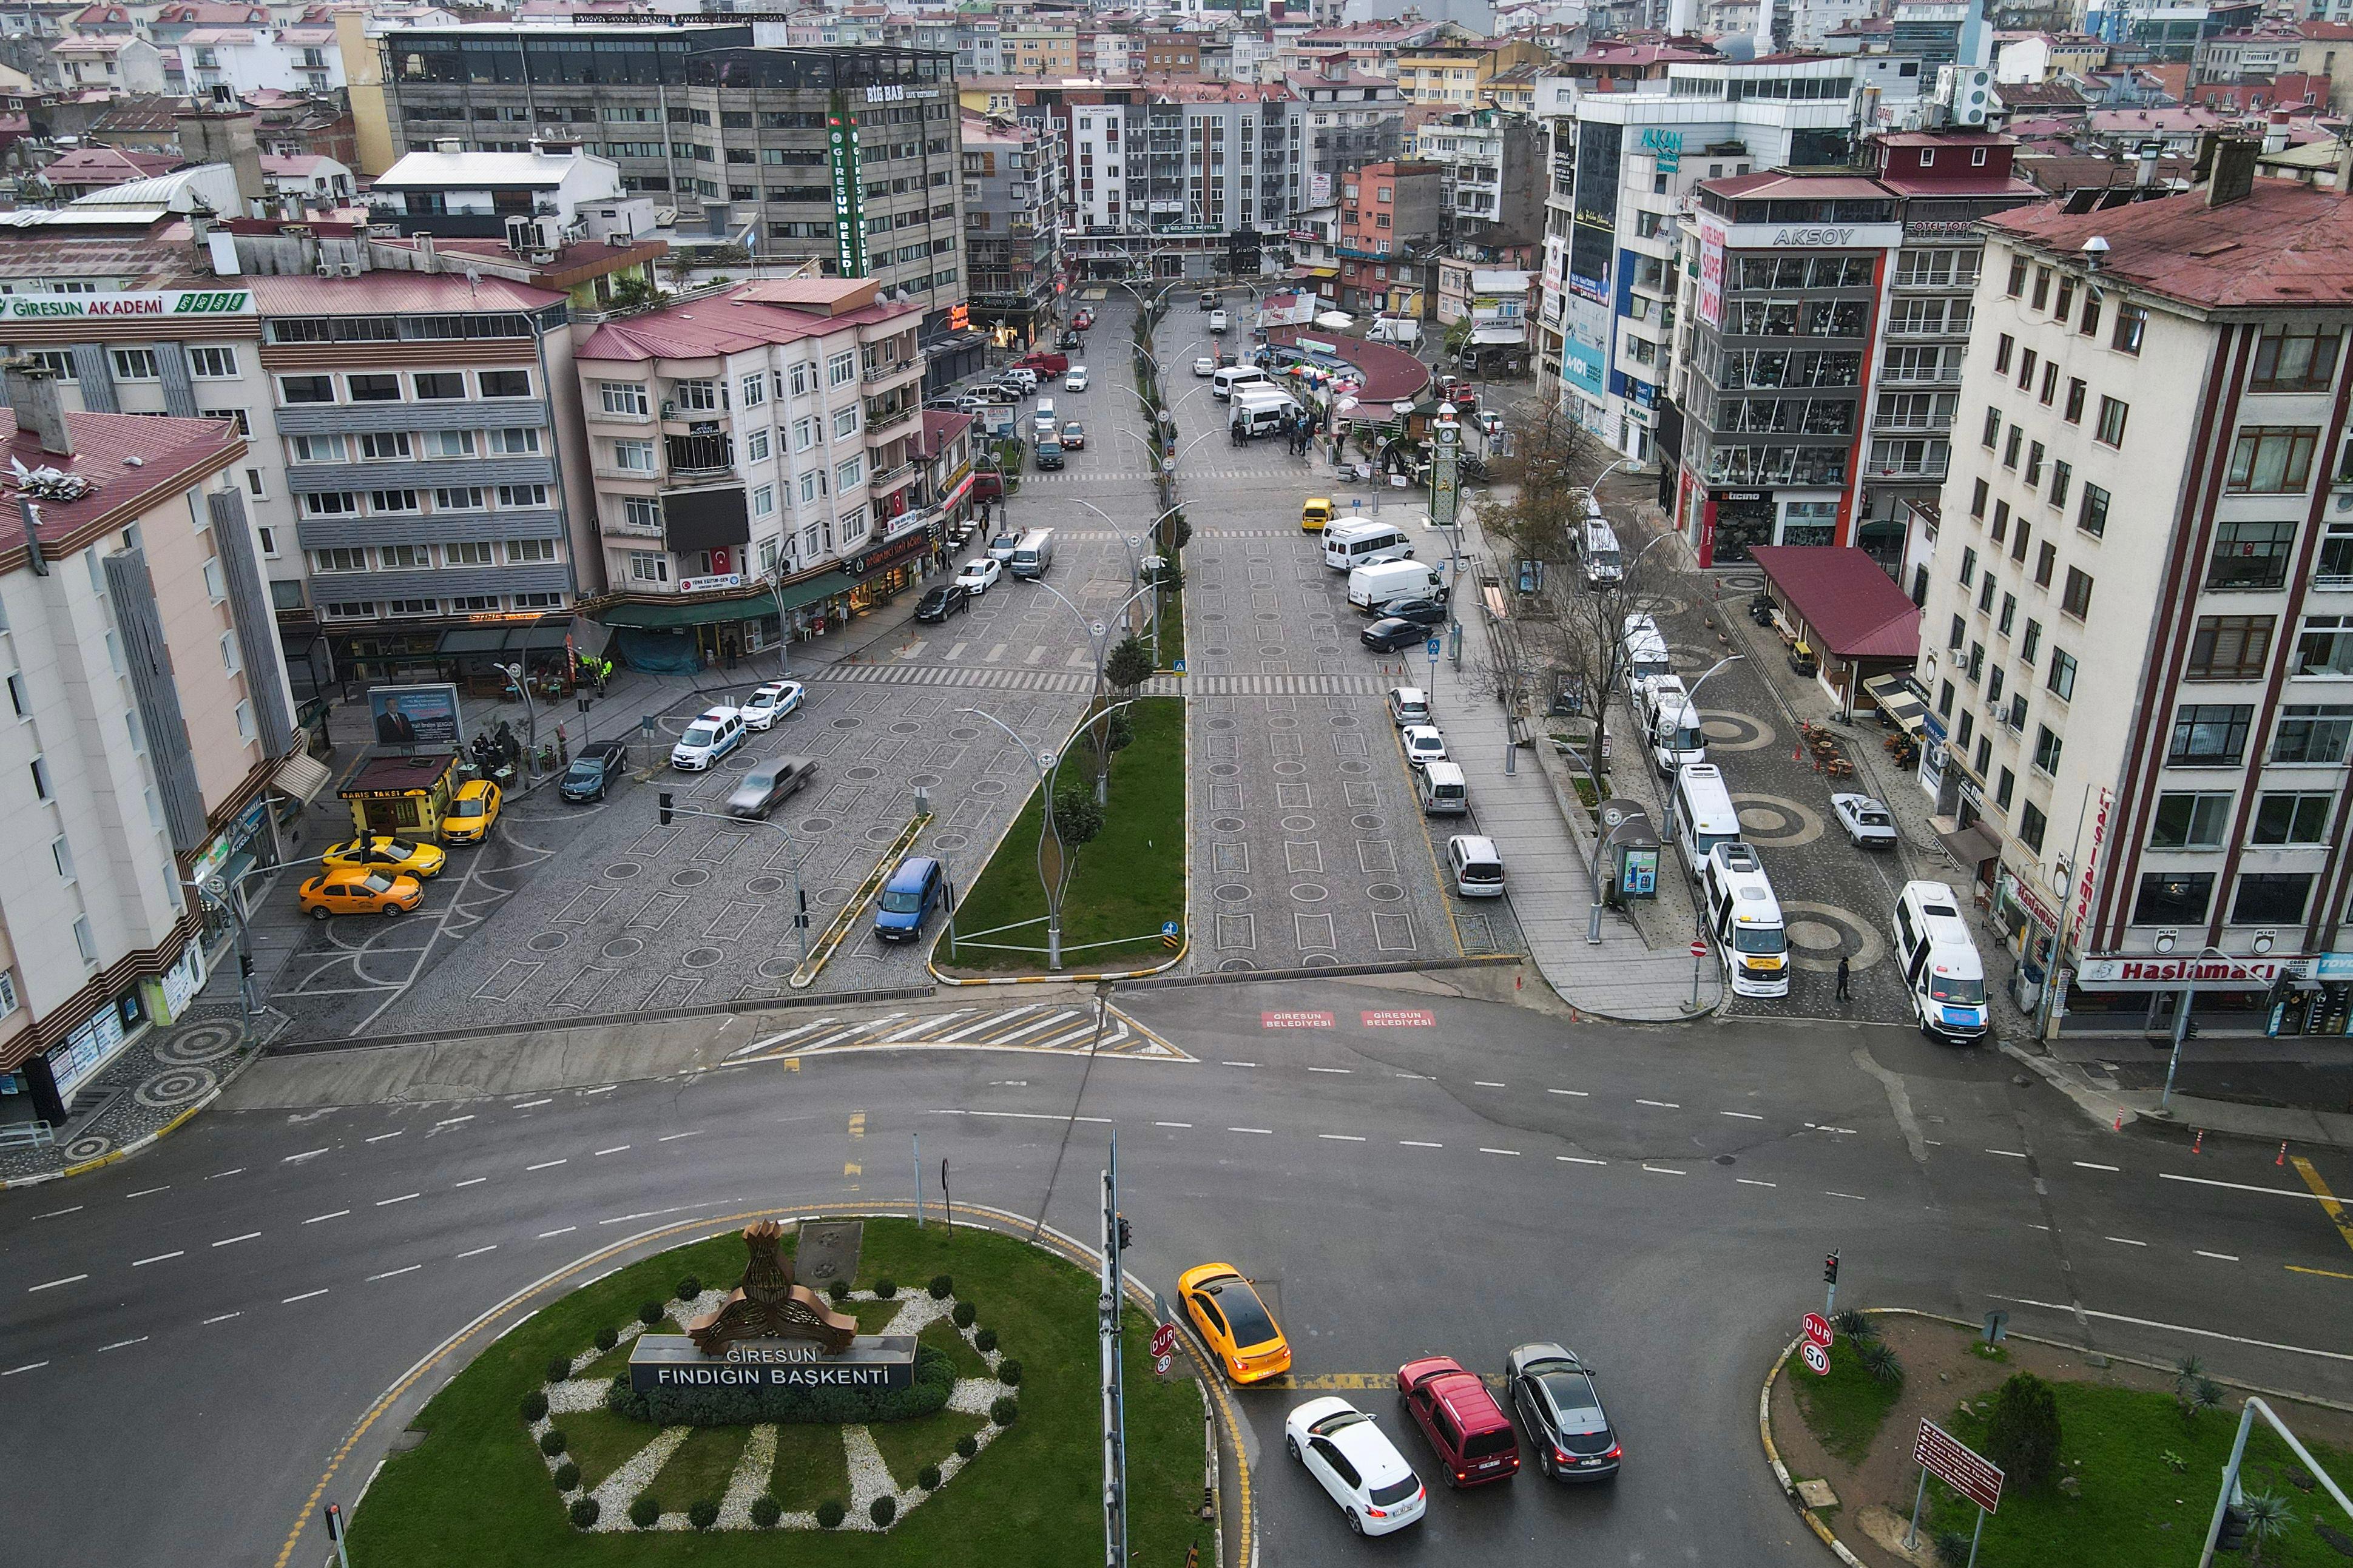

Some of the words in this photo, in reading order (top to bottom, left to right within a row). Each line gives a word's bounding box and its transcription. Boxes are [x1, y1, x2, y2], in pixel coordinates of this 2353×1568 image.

[884, 86, 903, 101] BAB
[833, 148, 848, 215] GİRESUN
[854, 147, 863, 214] GİRESUN
[859, 220, 869, 280] BELEDİ
[1773, 229, 1855, 245] AKSOY
[13, 298, 83, 316] GİRESUN
[89, 295, 163, 315] AKADEMİ
[197, 296, 208, 309] DGS
[2018, 886, 2057, 935] Haşlamac
[2121, 960, 2275, 981] Haşlamacı
[1806, 1317, 1830, 1342] DUR
[1153, 1330, 1173, 1353] DUR
[726, 1346, 817, 1363] GİRESUN
[1159, 1358, 1169, 1371] 50
[1806, 1347, 1825, 1368] 50
[658, 1364, 759, 1384] FINDIĞIN
[772, 1365, 888, 1388] BAŞKENTİ
